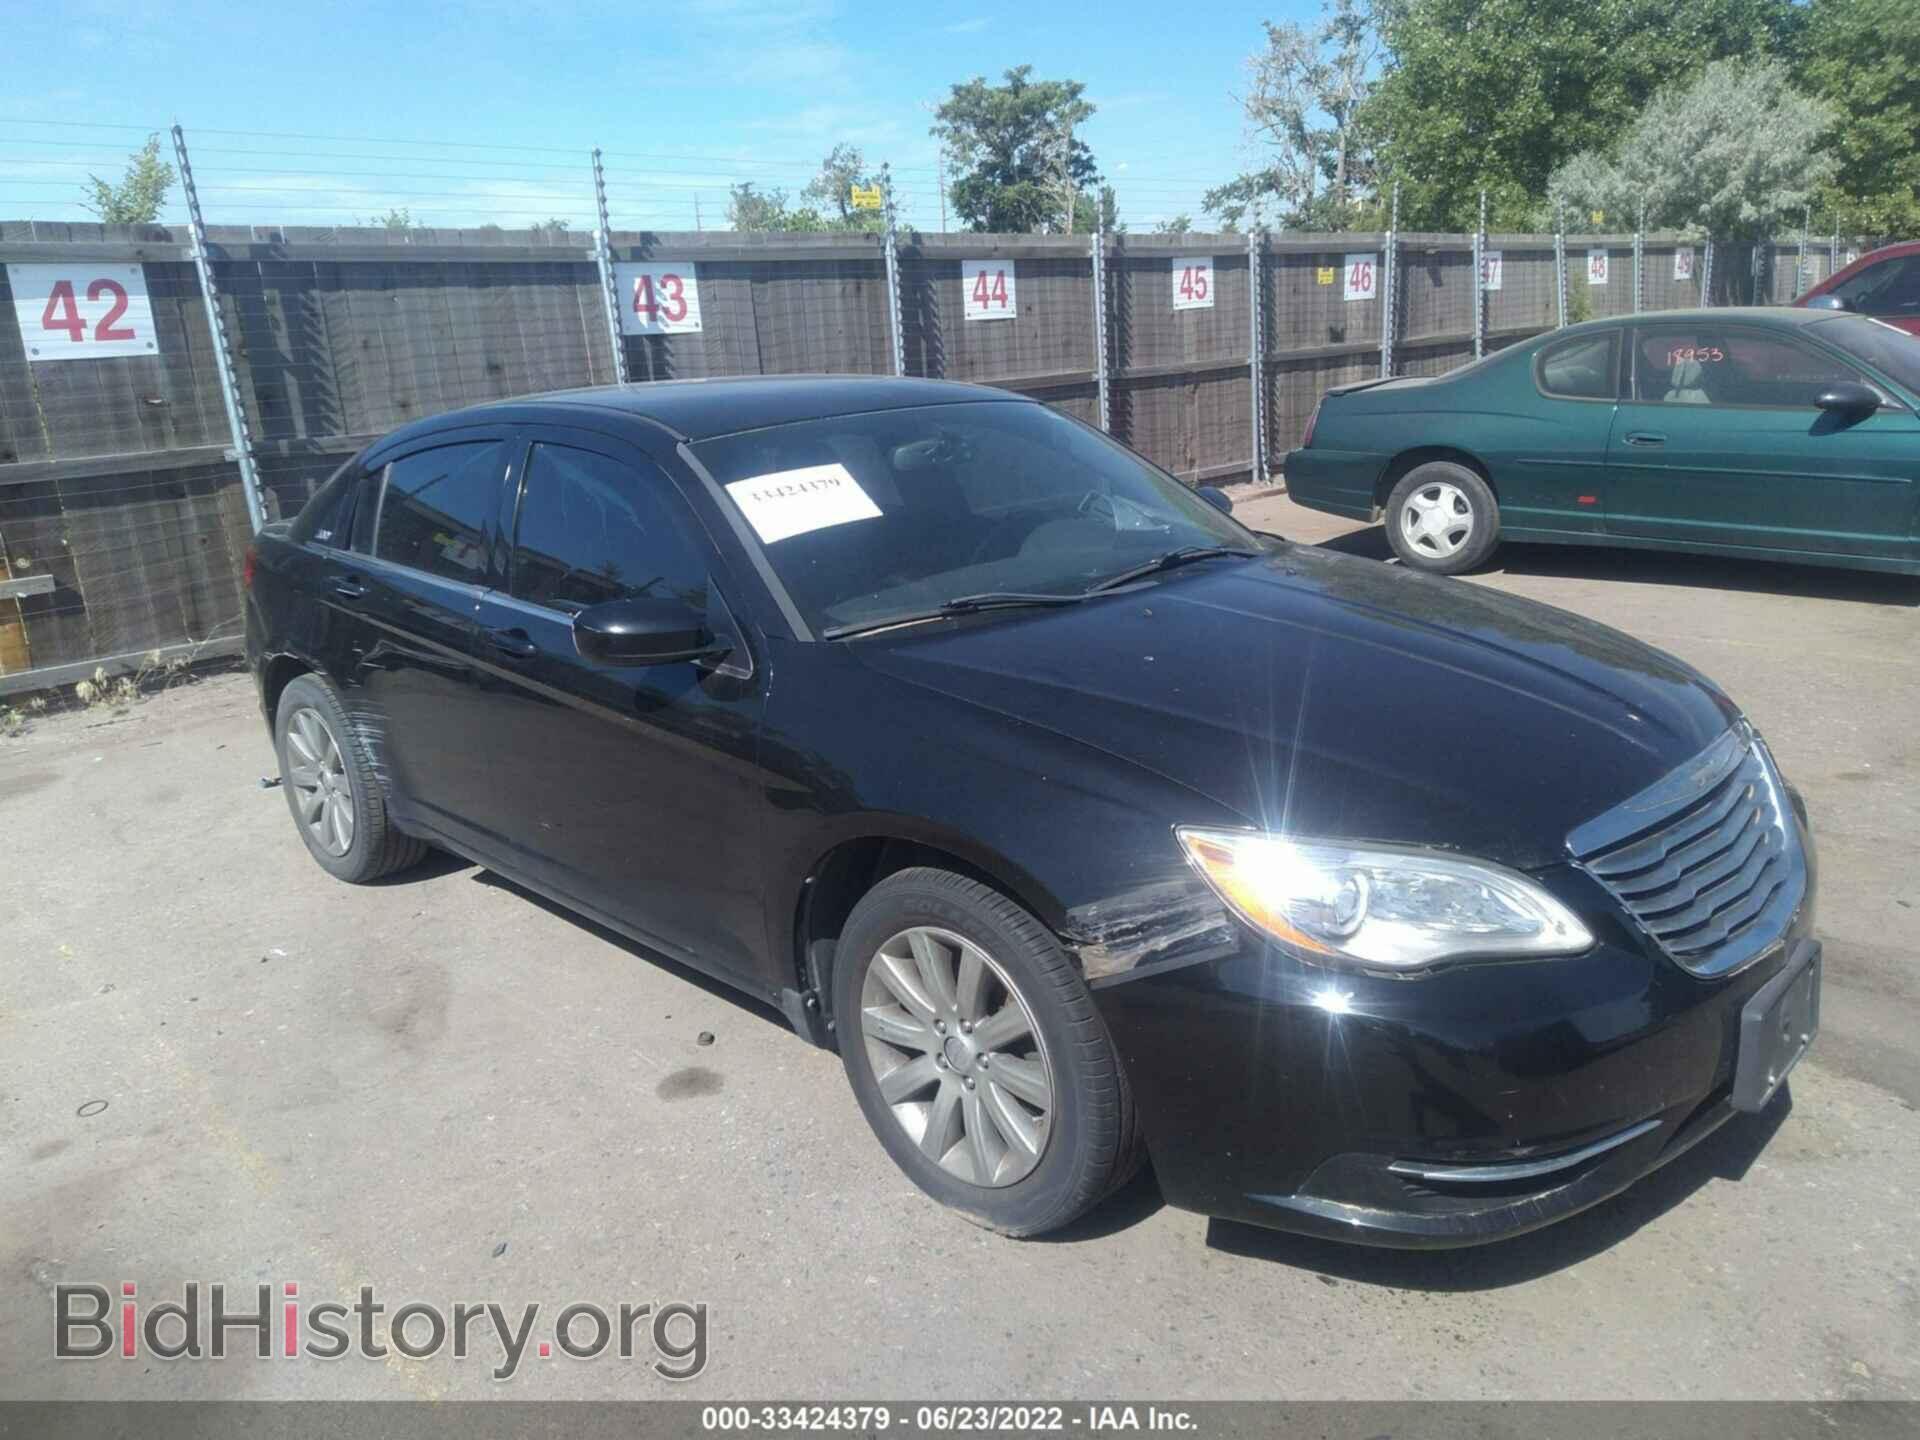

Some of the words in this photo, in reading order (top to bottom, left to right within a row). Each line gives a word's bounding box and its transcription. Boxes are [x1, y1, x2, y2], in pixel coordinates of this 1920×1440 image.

[1180, 265, 1208, 300] 45
[1349, 261, 1371, 292] 46
[1591, 255, 1605, 278] 48
[632, 274, 688, 322] 43
[972, 269, 1008, 310] 44
[41, 278, 136, 342] 42
[752, 478, 840, 502] 33424379
